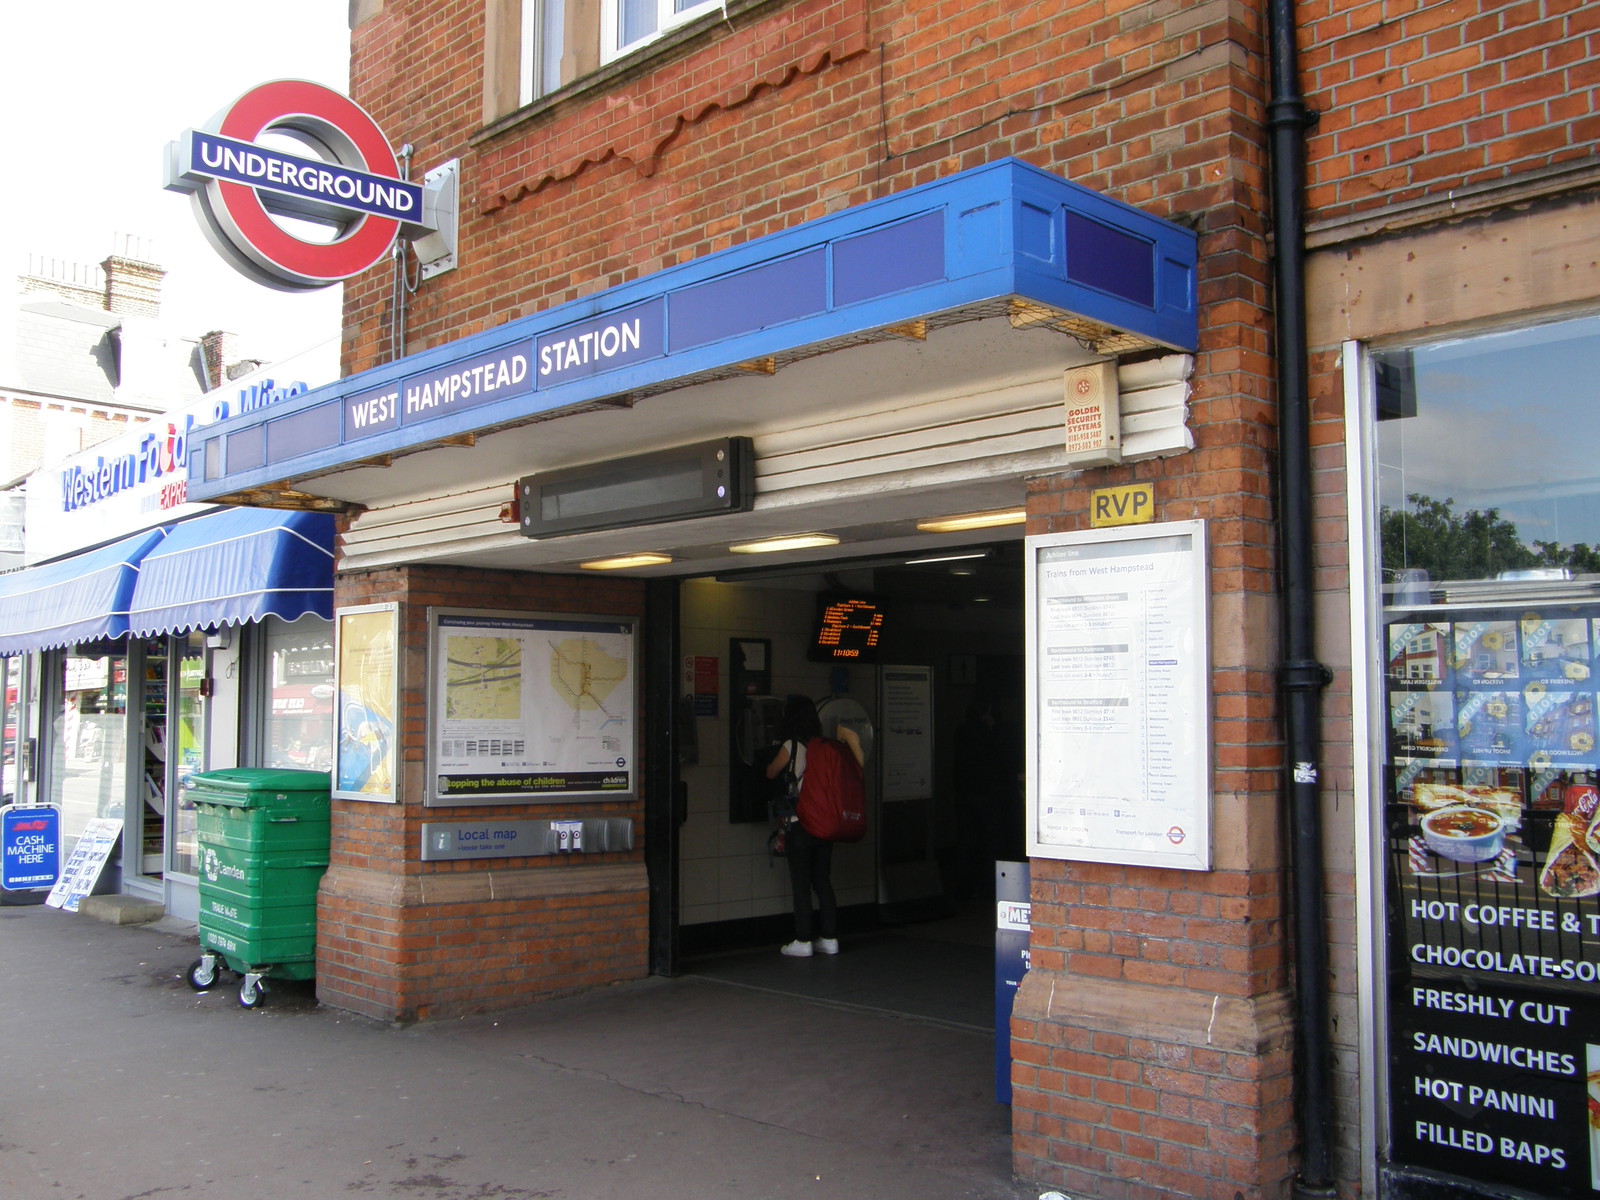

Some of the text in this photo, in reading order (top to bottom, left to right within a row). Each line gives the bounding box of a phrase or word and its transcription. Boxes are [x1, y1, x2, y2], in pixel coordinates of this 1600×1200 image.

[201, 142, 413, 211] UNDERGROUND
[352, 318, 640, 429] WEST HAMPSTEAD STATION
[1066, 413, 1102, 425] SECURITY
[1068, 405, 1100, 417] GOLDEN
[1067, 421, 1102, 433] SYSTEMS
[60, 453, 135, 513] Western
[1096, 491, 1148, 519] RVP
[1046, 570, 1067, 578] Trains
[1089, 567, 1108, 575] West
[1110, 563, 1154, 574] Hampstead
[833, 649, 859, 657] 11:10:59
[481, 778, 495, 787] the
[497, 777, 522, 787] abuse
[523, 776, 532, 786] of
[533, 776, 566, 785] children
[16, 835, 44, 845] CASH
[458, 829, 517, 844] Local map
[7, 843, 55, 856] MACHINE
[19, 853, 44, 864] HERE
[217, 861, 245, 881] Camden
[1411, 899, 1459, 922] HOT
[1464, 903, 1556, 931] COFFEE
[1561, 912, 1582, 934] &
[1413, 987, 1571, 1027] FRESHLY CUT
[1413, 1031, 1577, 1076] SANDWICHES
[1414, 1075, 1555, 1120] HOT PANINI
[1415, 1120, 1568, 1170] FILLED BAPS
